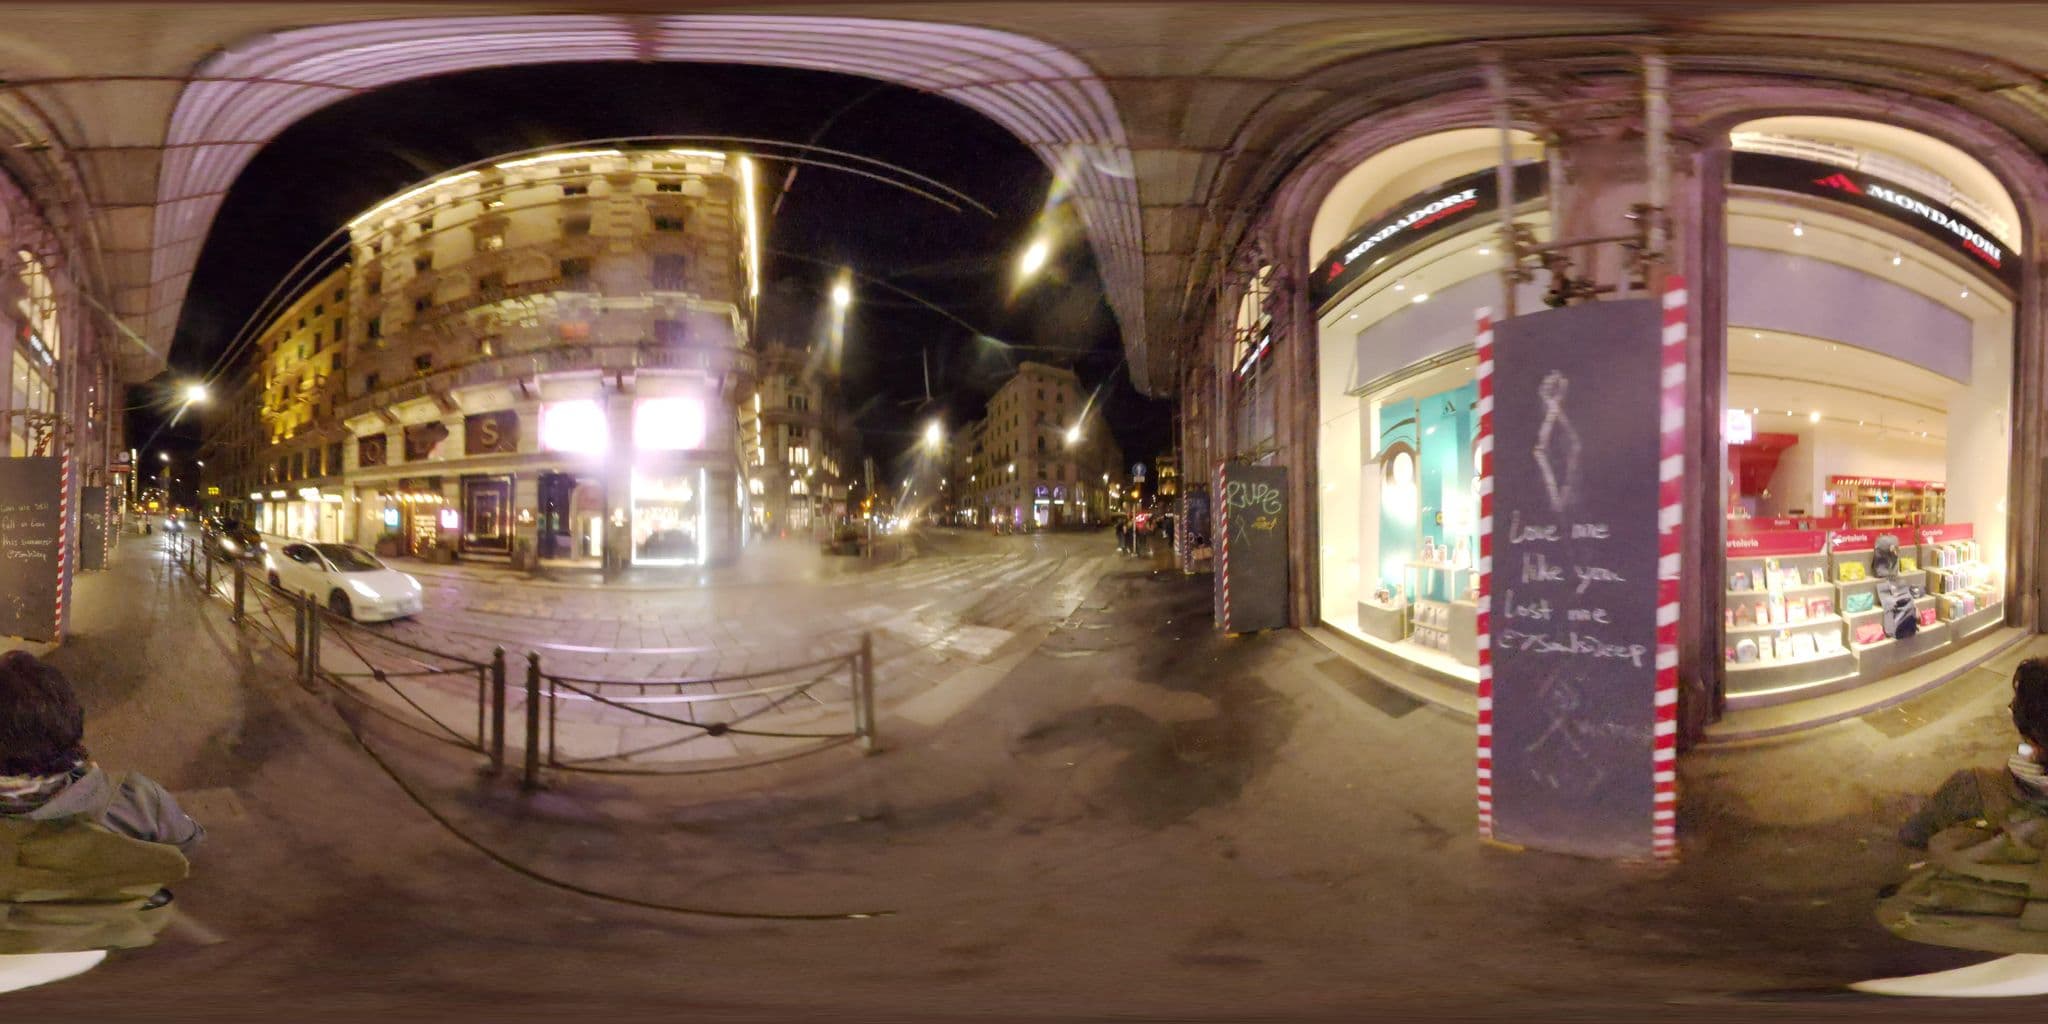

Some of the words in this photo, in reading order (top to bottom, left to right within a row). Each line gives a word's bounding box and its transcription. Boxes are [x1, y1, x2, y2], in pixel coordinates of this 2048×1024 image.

[1344, 188, 1478, 265] MONDADORI
[1866, 184, 2001, 260] MONDADORI
[1571, 523, 1610, 540] me
[1574, 564, 1626, 594] you
[1567, 608, 1610, 624] me
